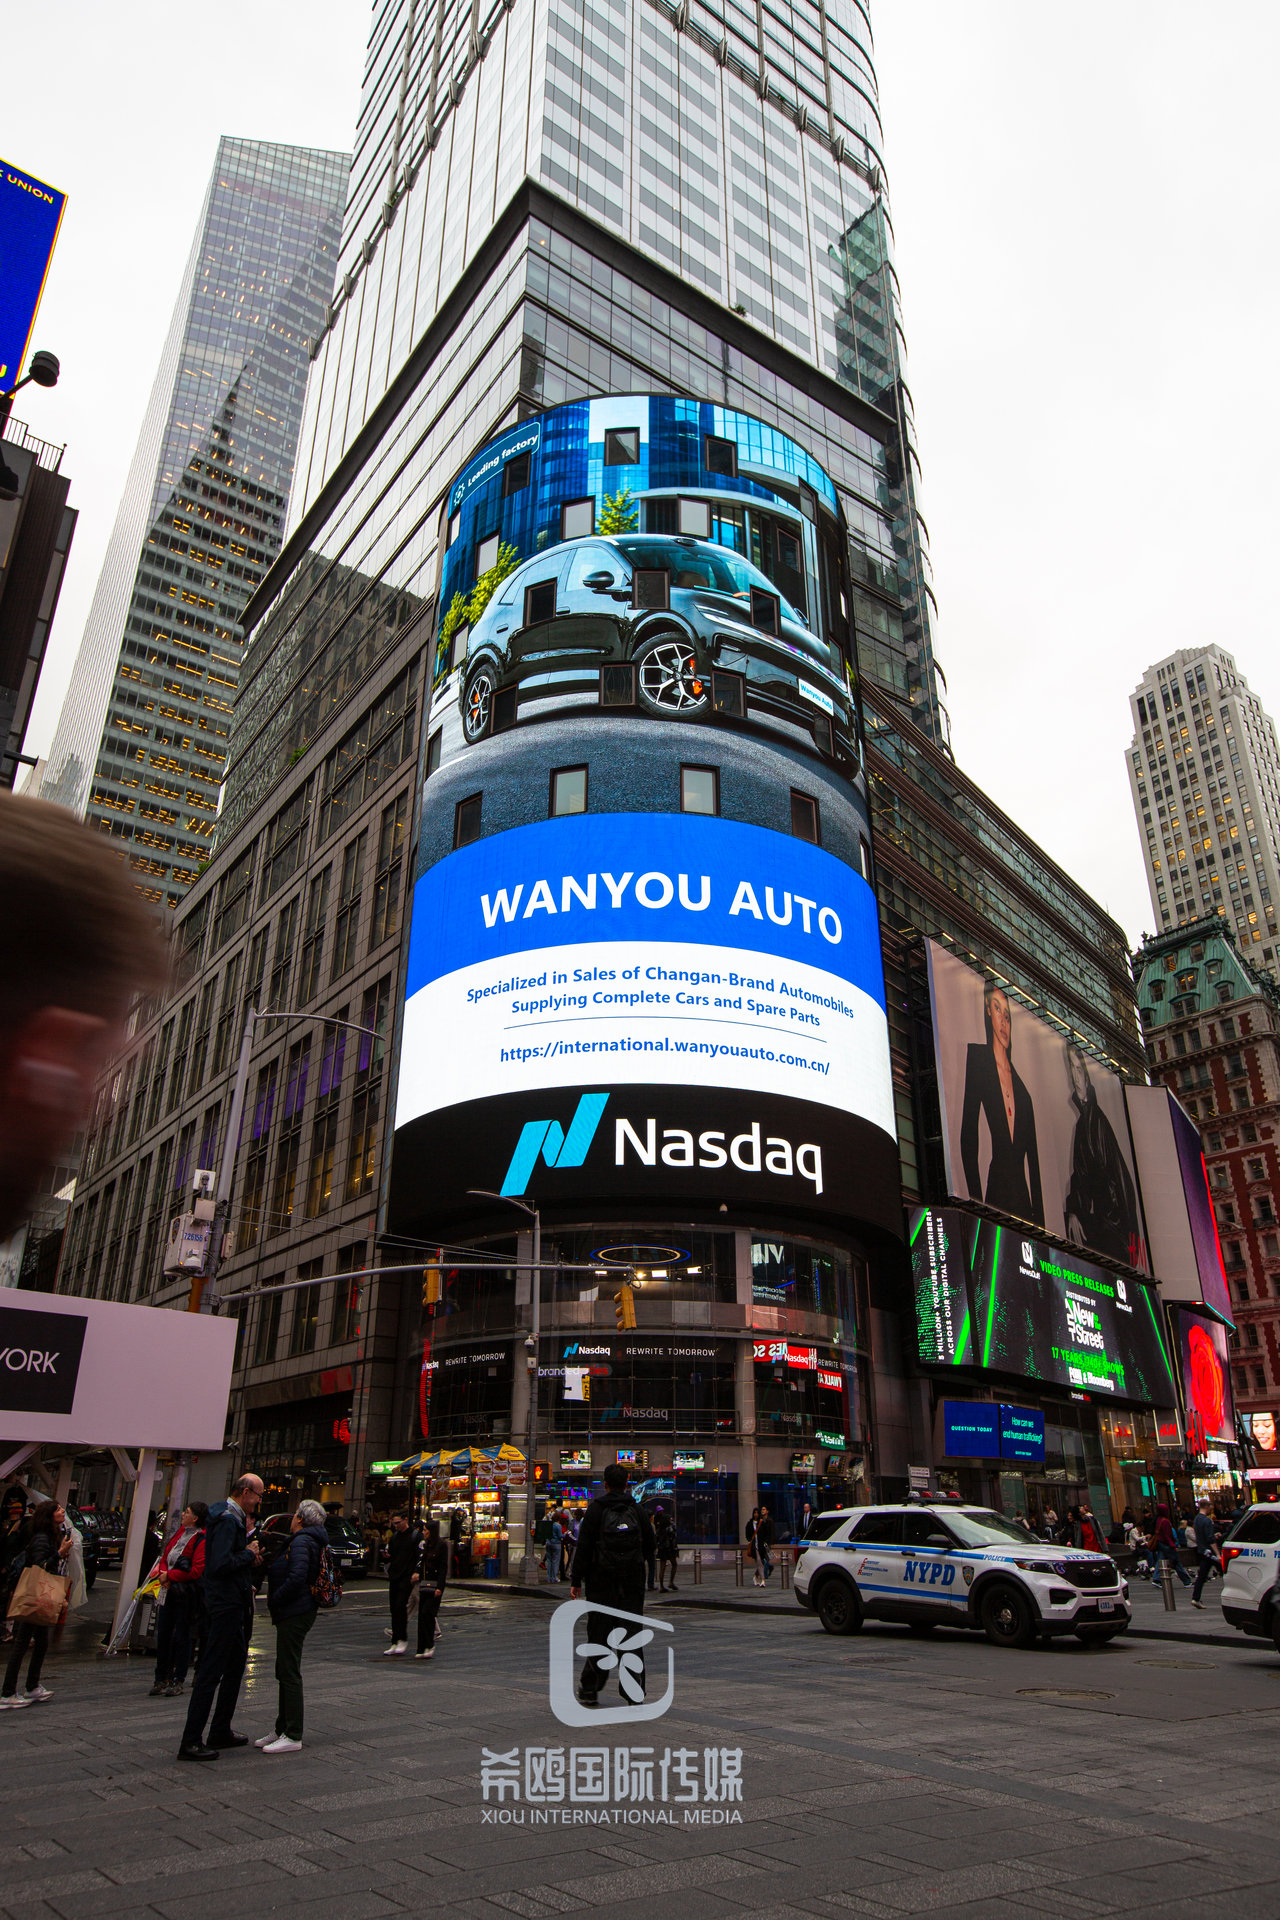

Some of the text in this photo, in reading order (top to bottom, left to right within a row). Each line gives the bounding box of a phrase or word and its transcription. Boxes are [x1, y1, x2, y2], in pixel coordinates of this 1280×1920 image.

[7, 173, 54, 204] UNION
[467, 434, 539, 487] Leading factory
[480, 871, 842, 945] WANYOU AUTO
[466, 966, 854, 1019] Specialized in Sales of Changan-Brand Automobiles
[511, 990, 821, 1026] Supplying Complete Cars and Spare Parts
[500, 1037, 830, 1076] https://international.wanyouauto.com.cn/
[615, 1118, 824, 1195] Nasdaq
[925, 1211, 937, 1267] SUBSCRIBERS
[936, 1217, 947, 1261] CHANNELS
[930, 1269, 940, 1309] YOUTUBE
[940, 1264, 950, 1297] DIGITAL
[1040, 1259, 1115, 1298] VIDEO PRESS RELEASES
[1065, 1290, 1096, 1307] DISTRIBUTED BY
[1072, 1301, 1095, 1329] New
[935, 1311, 944, 1353] MILLION+
[946, 1320, 955, 1355] ACROSS
[1075, 1323, 1104, 1350] Street
[445, 1357, 467, 1366] REWRITE
[469, 1352, 506, 1363] TOMORROW
[578, 1345, 716, 1356] Nasdaq REWRITE TOMORROW
[784, 1354, 808, 1366] Nasdaq
[1051, 1346, 1059, 1360] 17
[623, 1406, 669, 1421] Nasdaq
[1011, 1417, 1021, 1426] How
[1020, 1419, 1028, 1427] can
[1002, 1430, 1043, 1445] end human trafficking?
[903, 1560, 956, 1586] NYPD
[984, 1554, 1005, 1562] POLICE
